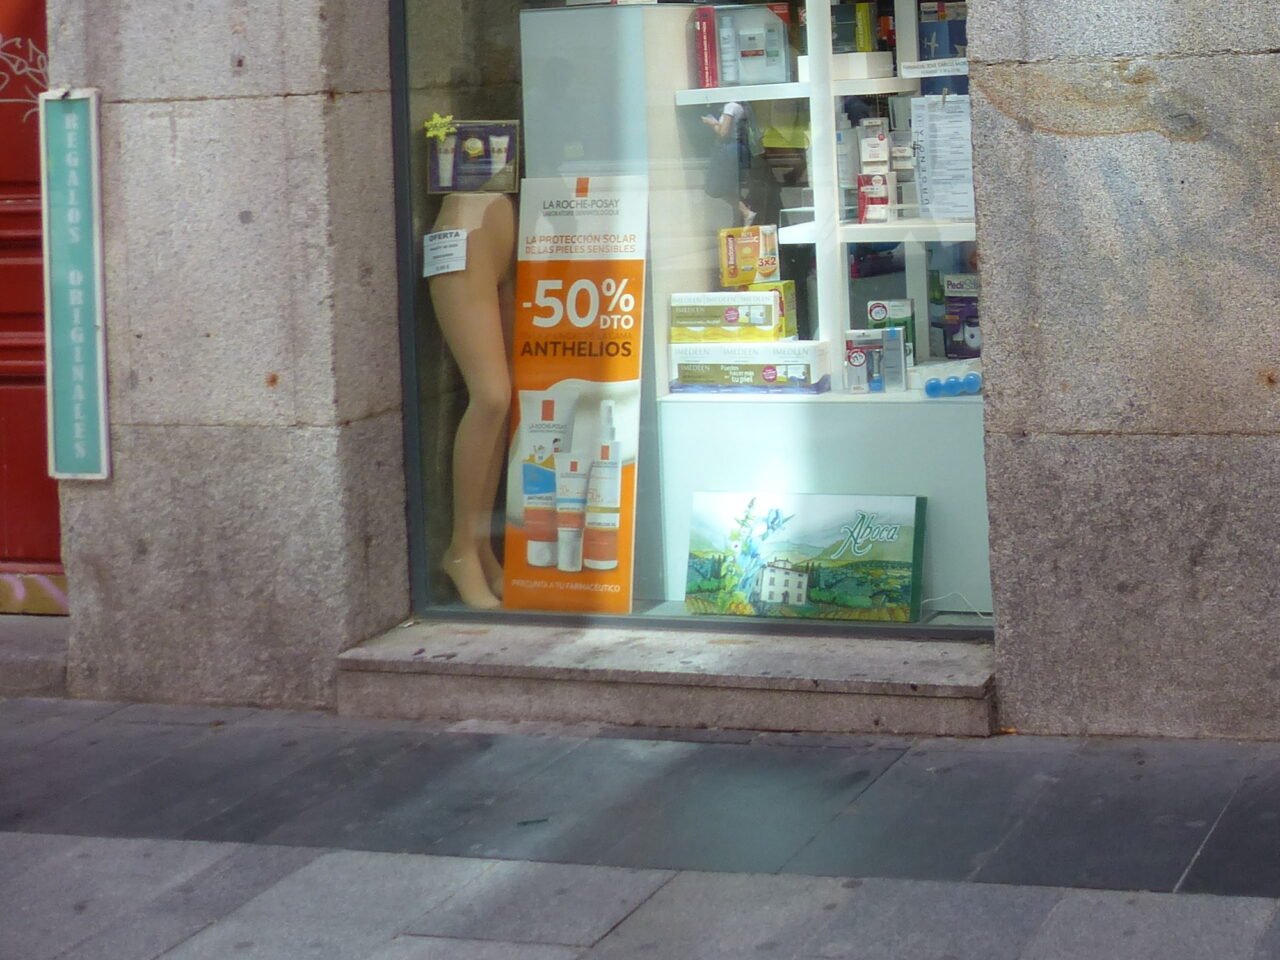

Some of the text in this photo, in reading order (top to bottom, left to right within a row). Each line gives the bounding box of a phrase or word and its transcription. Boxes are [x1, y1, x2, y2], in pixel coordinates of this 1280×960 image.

[543, 199, 620, 210] LA ROCHE-POSAY
[429, 231, 460, 242] OFERTA
[526, 235, 537, 245] LA
[603, 234, 636, 244] SOLAR
[525, 244, 636, 255] DE LAS PIELES SENSIBLES
[758, 256, 777, 267] 3x2
[64, 112, 87, 459] REGALOS ORIGINALES
[600, 314, 634, 330] DTO
[520, 341, 632, 357] ANTHELIOS
[831, 509, 900, 560] Aboca
